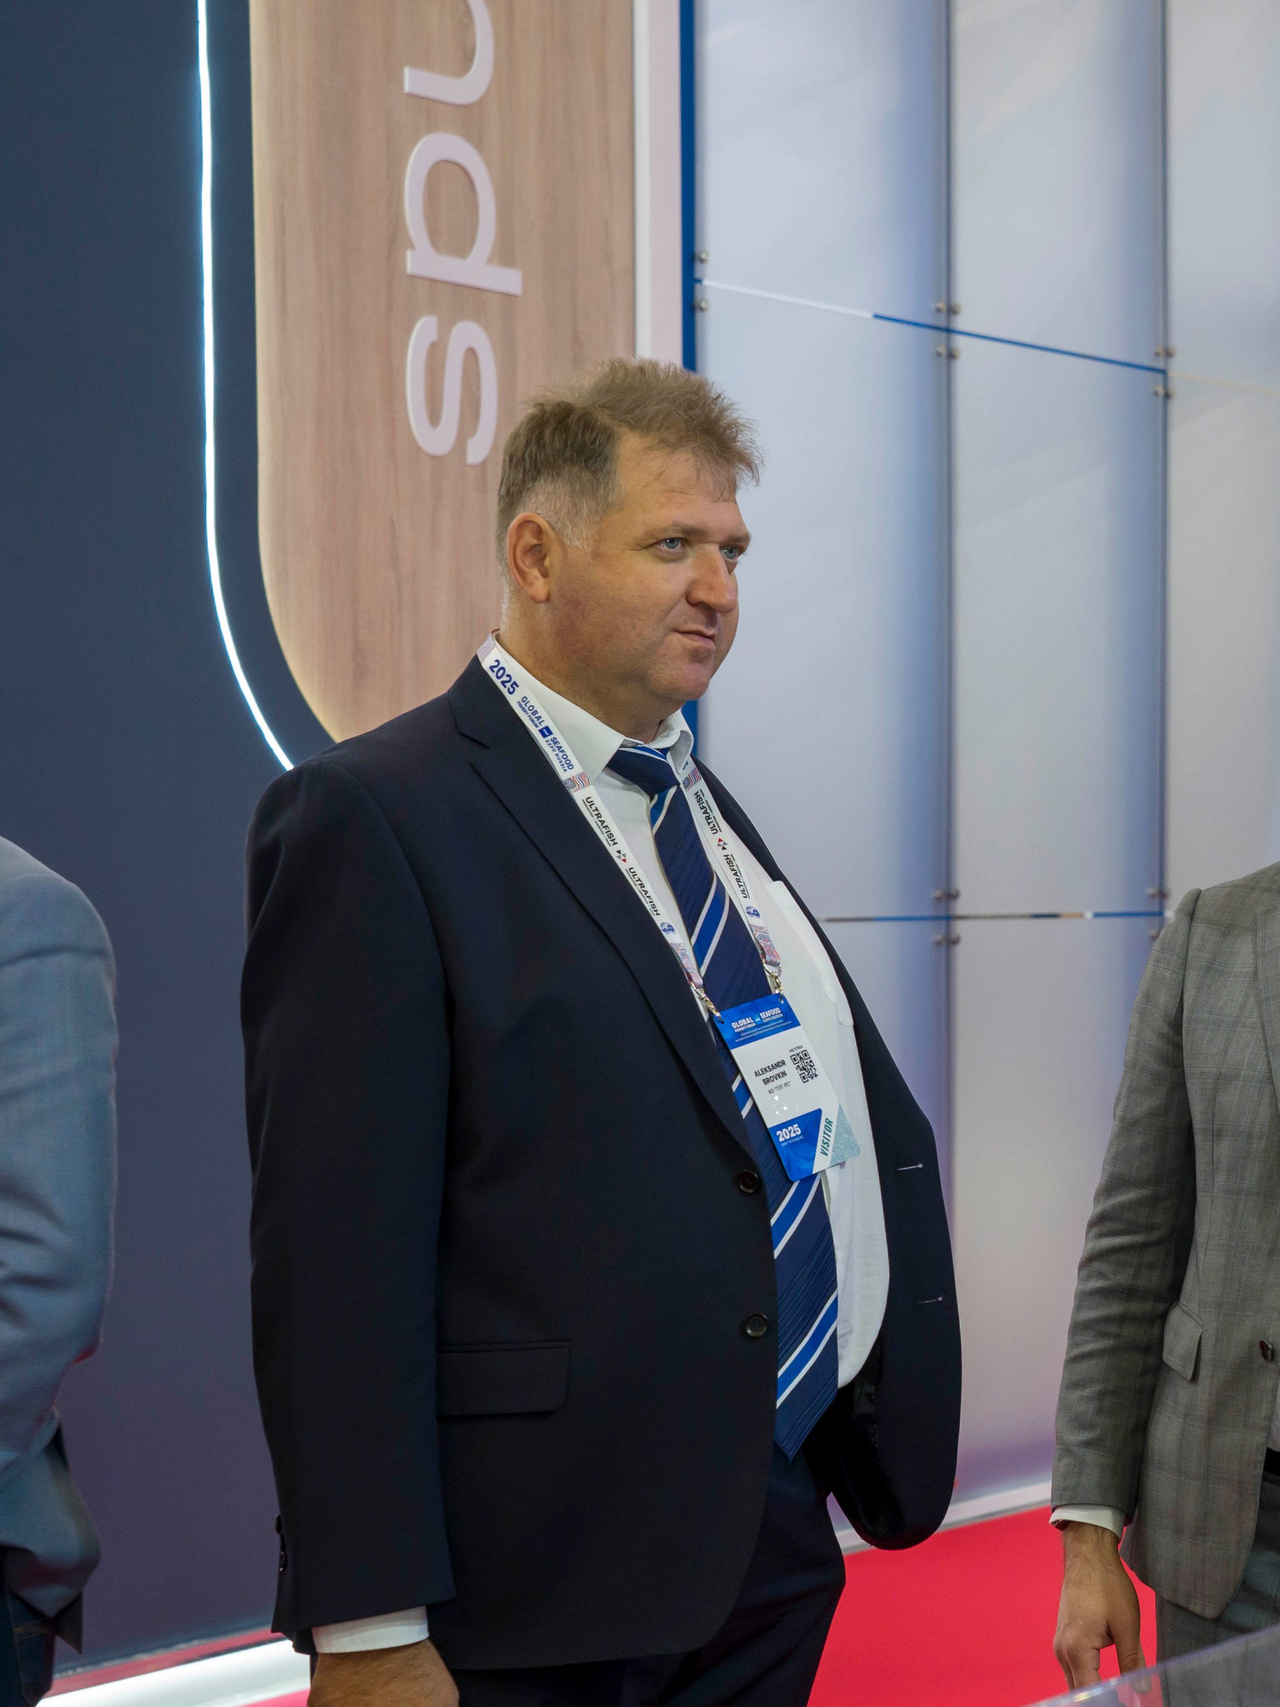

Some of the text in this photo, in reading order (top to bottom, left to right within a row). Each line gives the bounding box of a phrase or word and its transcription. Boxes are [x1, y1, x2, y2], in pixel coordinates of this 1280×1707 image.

[489, 659, 519, 695] 2025
[521, 696, 545, 726] GLOBAL
[550, 737, 575, 771] SEAFOOD
[586, 796, 618, 846] ULTRAFISH
[693, 790, 719, 835] ULTRAFISH
[628, 867, 660, 916] ULTRAFISH
[723, 854, 748, 899] ULTRAFISH
[732, 1017, 754, 1029] GLOBAL
[760, 1007, 782, 1019] SEAFOOD
[754, 1059, 787, 1078] ALEKSANDR
[762, 1070, 788, 1086] BROVKIN
[776, 1123, 802, 1142] 2025
[820, 1117, 834, 1157] VISITOR
